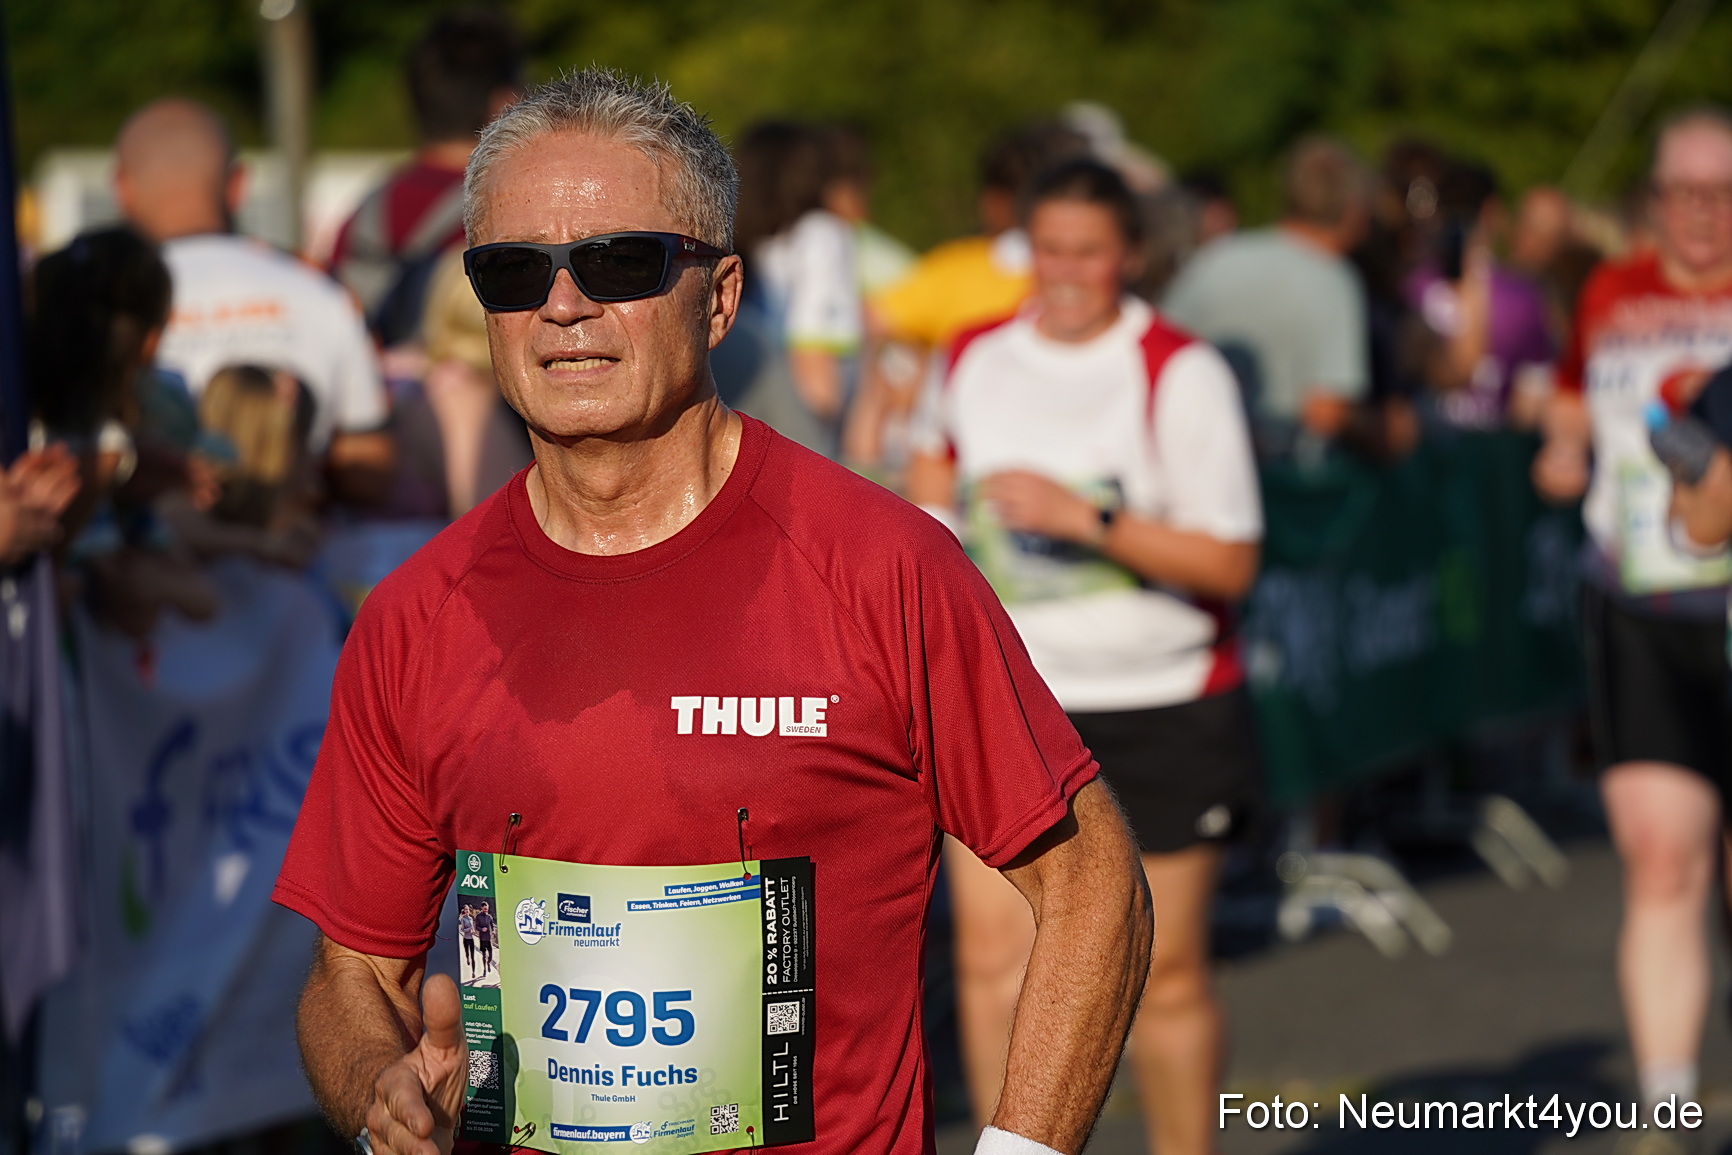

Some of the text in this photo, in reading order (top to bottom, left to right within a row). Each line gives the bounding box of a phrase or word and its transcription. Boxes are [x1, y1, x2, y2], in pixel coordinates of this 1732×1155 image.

[671, 696, 827, 737] THULE
[785, 725, 822, 734] SWEDEN
[461, 874, 489, 889] AOK
[668, 880, 744, 895] Laufen, Joggen, Walken
[563, 905, 589, 914] Fischer
[630, 893, 741, 911] Essen, Trinken, Feiern, Netzwerken
[548, 921, 622, 937] Firmenlauf
[764, 876, 778, 985] 20 % RABATT
[780, 876, 792, 983] FACTORY OUTLET
[573, 937, 620, 947] neumarkt
[539, 983, 696, 1047] 2795
[547, 1058, 698, 1087] Dennis Fuchs
[773, 1041, 789, 1121] HILTL
[591, 1093, 636, 1103] Thule GmbH
[553, 1127, 626, 1141] firmenlauf.bayern
[653, 1123, 696, 1137] Firmenlauf
